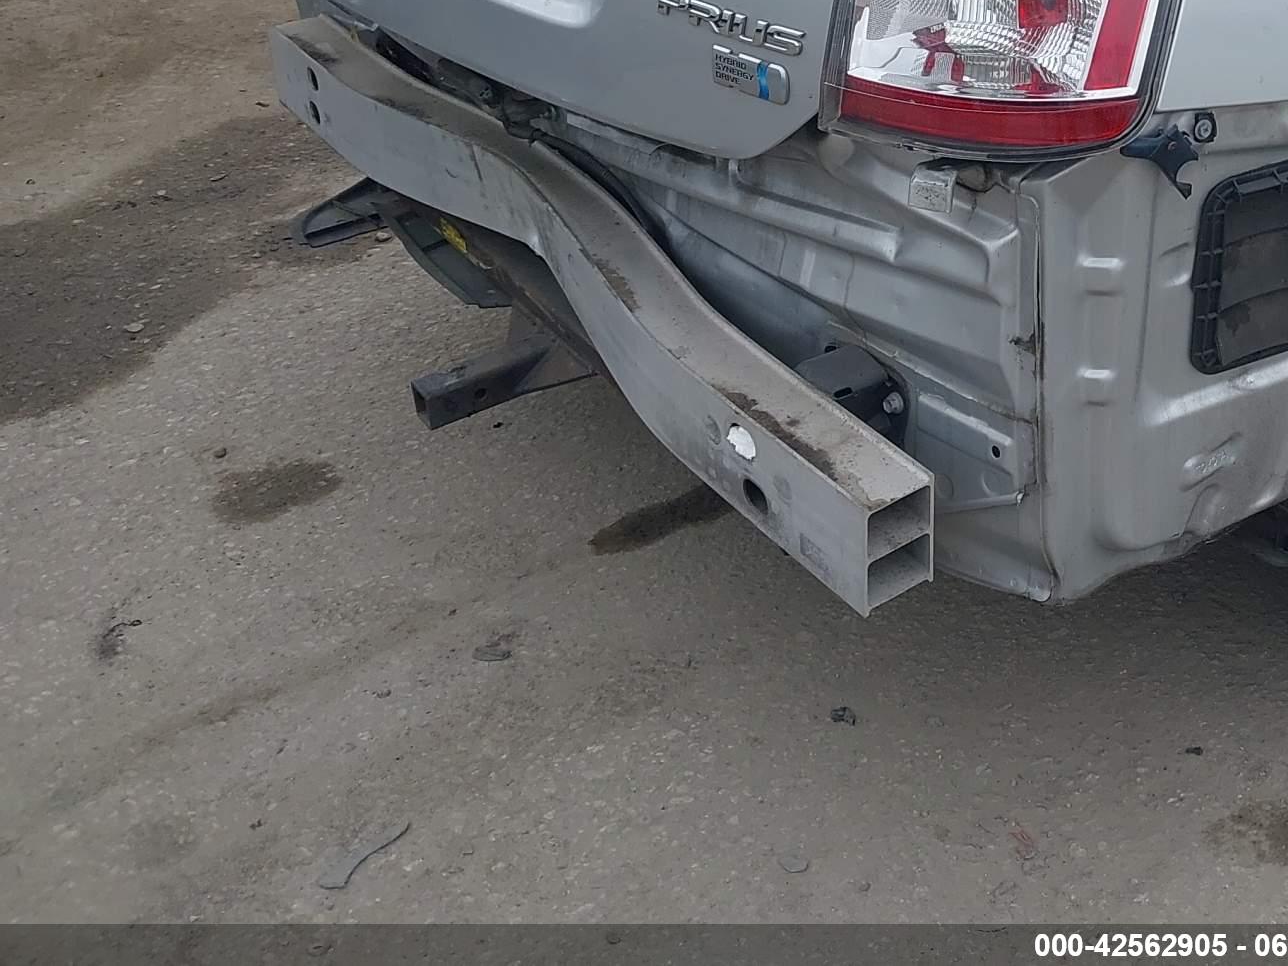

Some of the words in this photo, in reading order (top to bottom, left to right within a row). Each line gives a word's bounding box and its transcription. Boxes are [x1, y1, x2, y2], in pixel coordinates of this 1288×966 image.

[715, 54, 747, 70] HYBRID
[715, 62, 754, 81] SYNERGY
[715, 71, 741, 85] DRIVE
